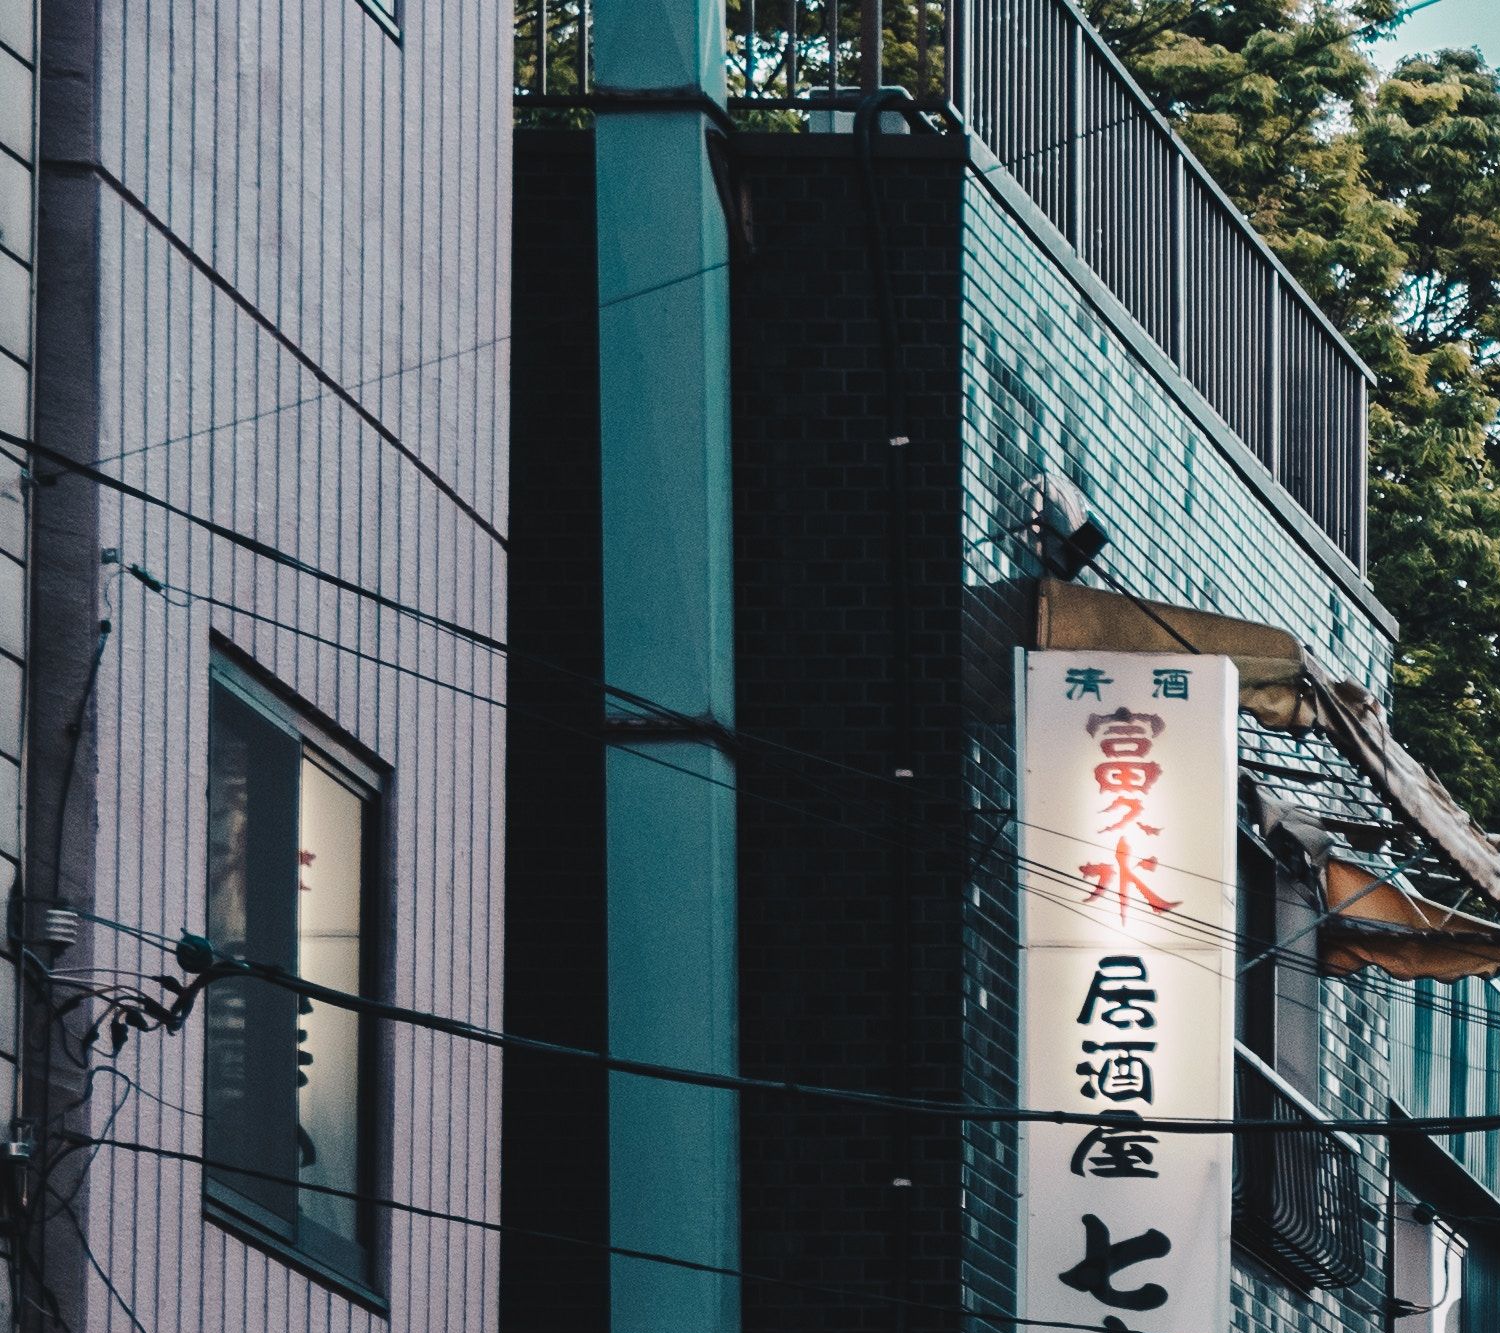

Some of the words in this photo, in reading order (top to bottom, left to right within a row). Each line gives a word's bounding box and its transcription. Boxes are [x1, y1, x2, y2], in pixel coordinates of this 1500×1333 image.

[1065, 667, 1193, 701] 清酒
[1071, 956, 1159, 1179] 居酒屋
